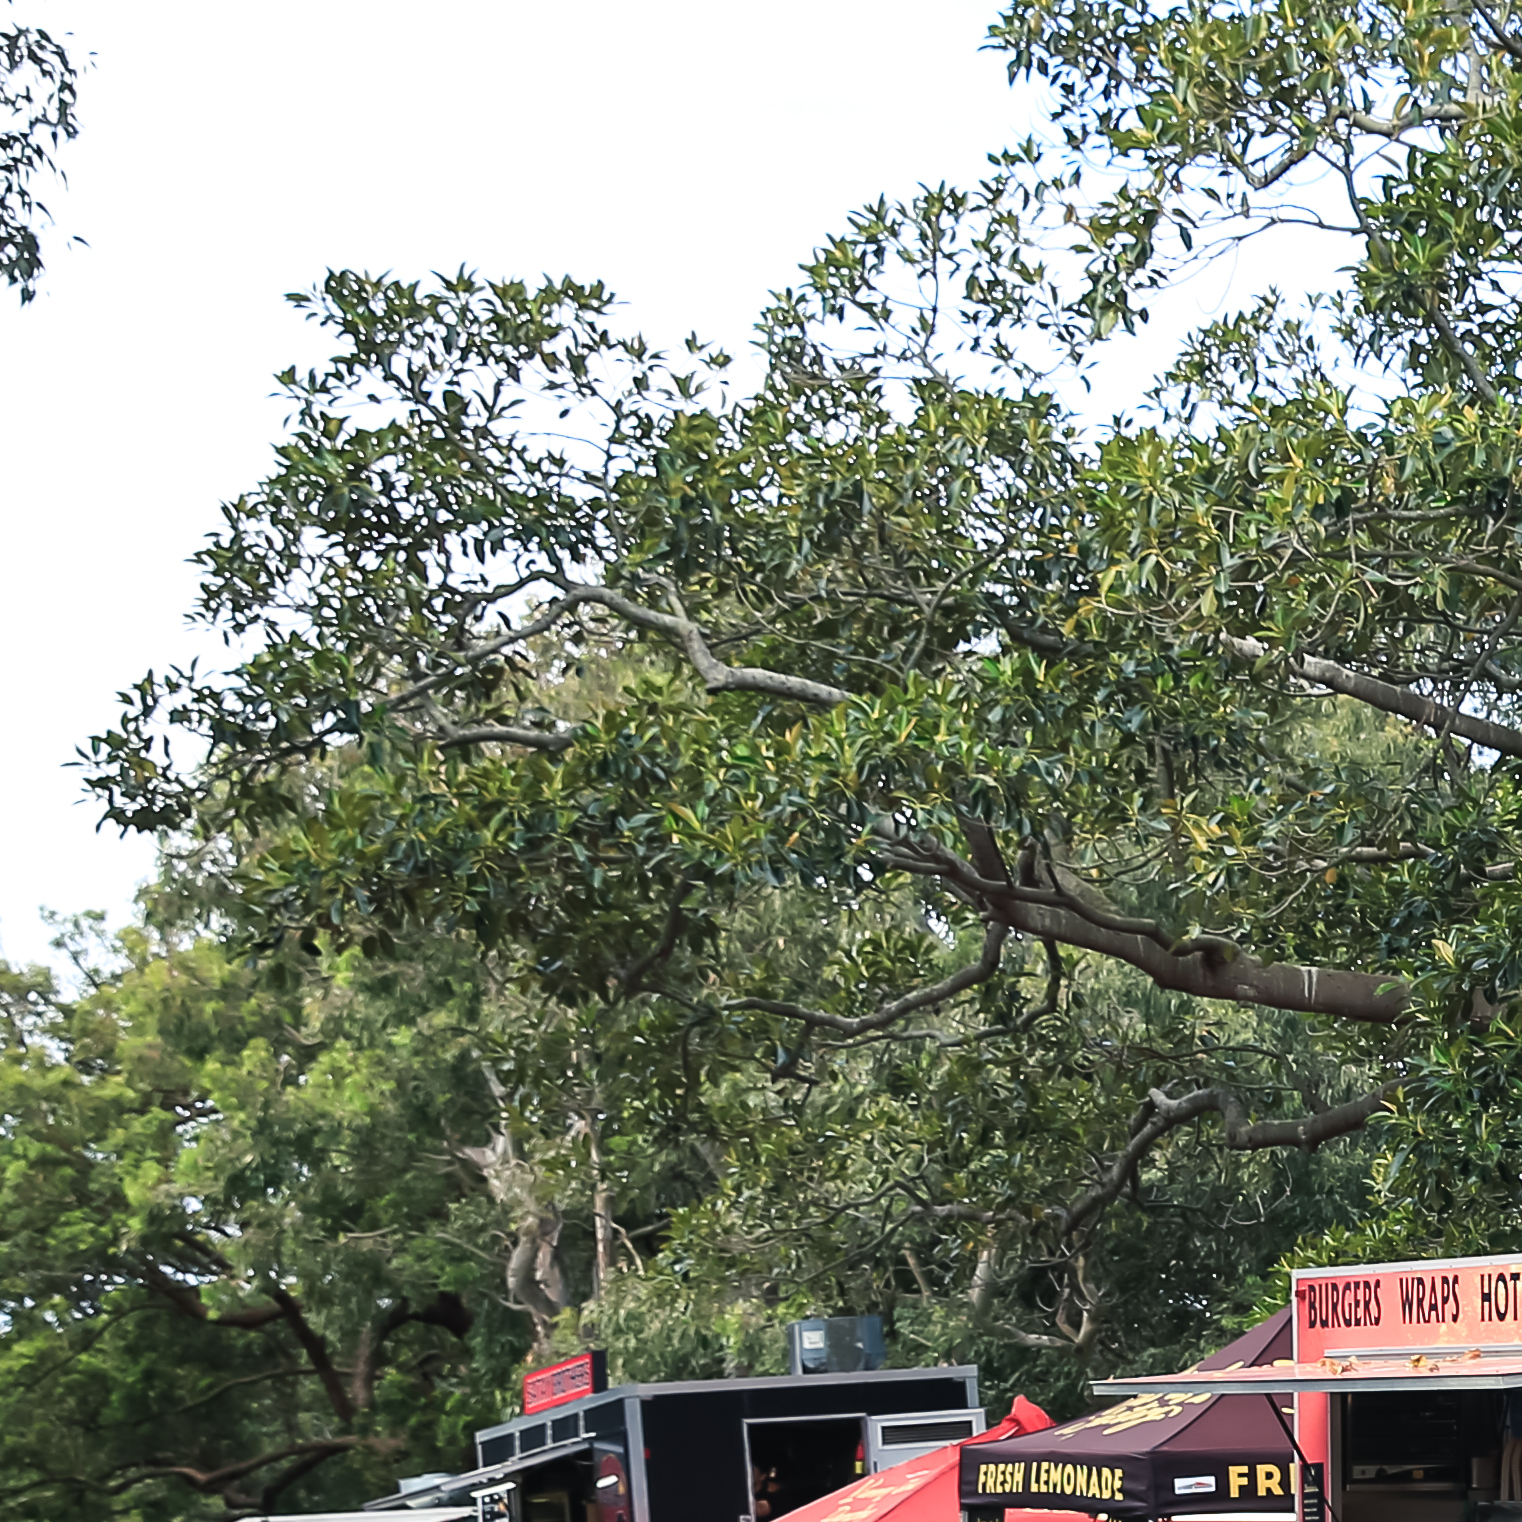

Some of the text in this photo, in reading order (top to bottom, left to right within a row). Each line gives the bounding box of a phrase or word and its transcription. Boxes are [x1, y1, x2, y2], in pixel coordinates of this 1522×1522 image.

[1308, 1279, 1381, 1329] BURGERS
[1399, 1274, 1460, 1324] WRAPS
[1480, 1271, 1521, 1322] HOT
[978, 1462, 1125, 1501] FRESH LEMONADE
